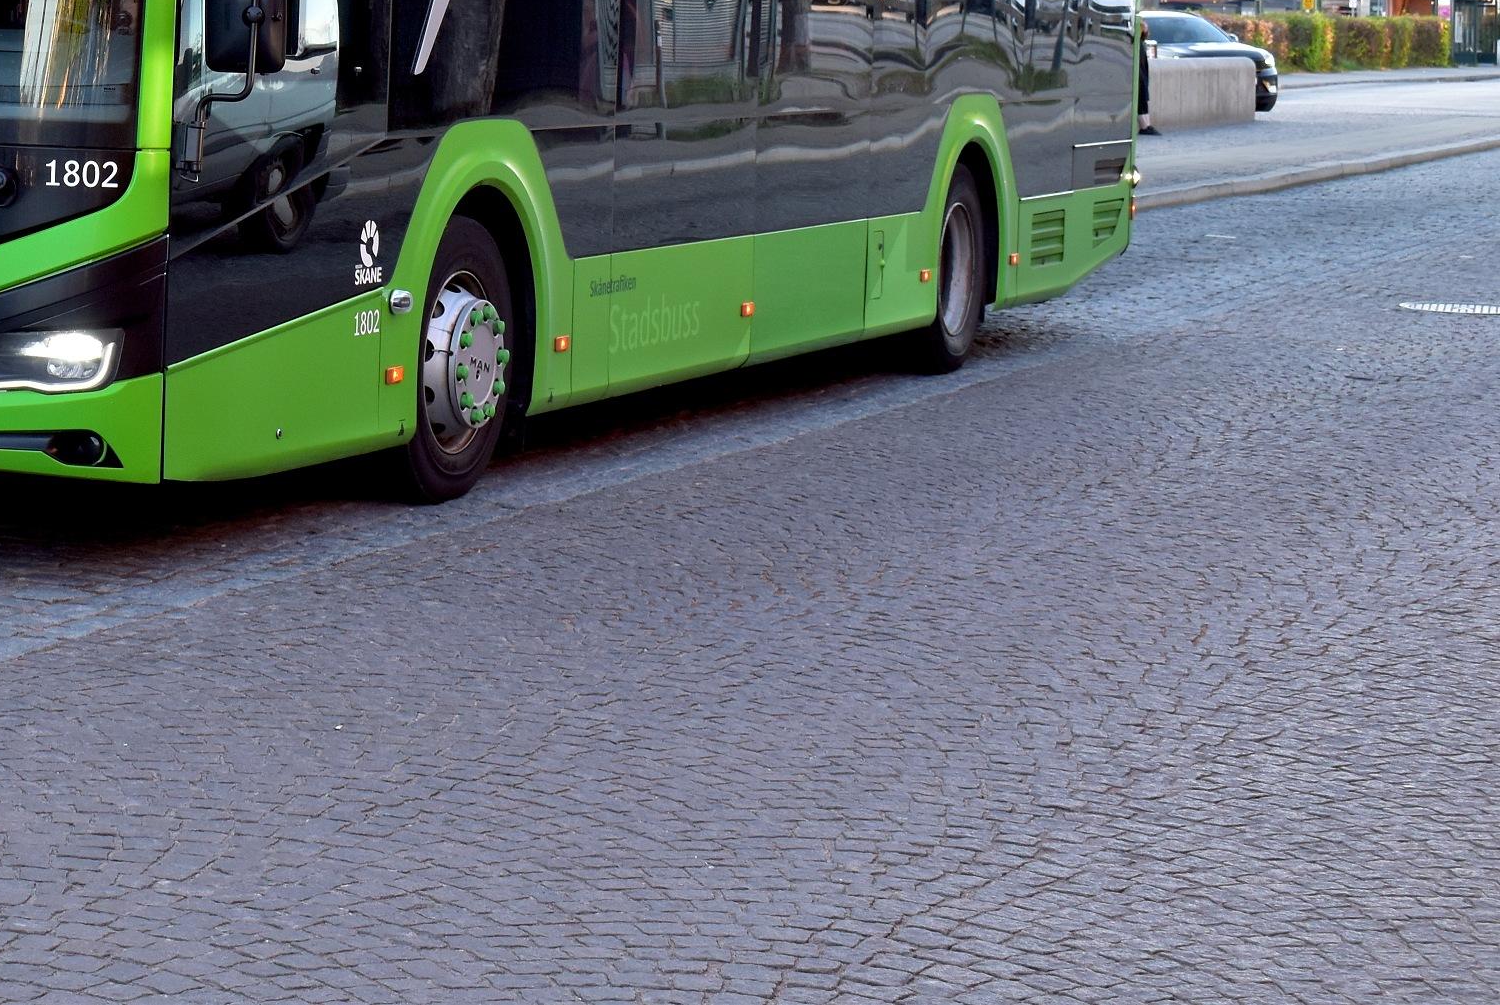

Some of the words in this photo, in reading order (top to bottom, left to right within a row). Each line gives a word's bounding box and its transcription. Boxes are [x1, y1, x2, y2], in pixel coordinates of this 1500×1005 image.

[45, 159, 119, 188] 1802
[590, 275, 637, 298] Skånetrafiken
[354, 309, 380, 337] 1802
[609, 296, 700, 354] Stadsbuss
[470, 356, 490, 372] MAN
